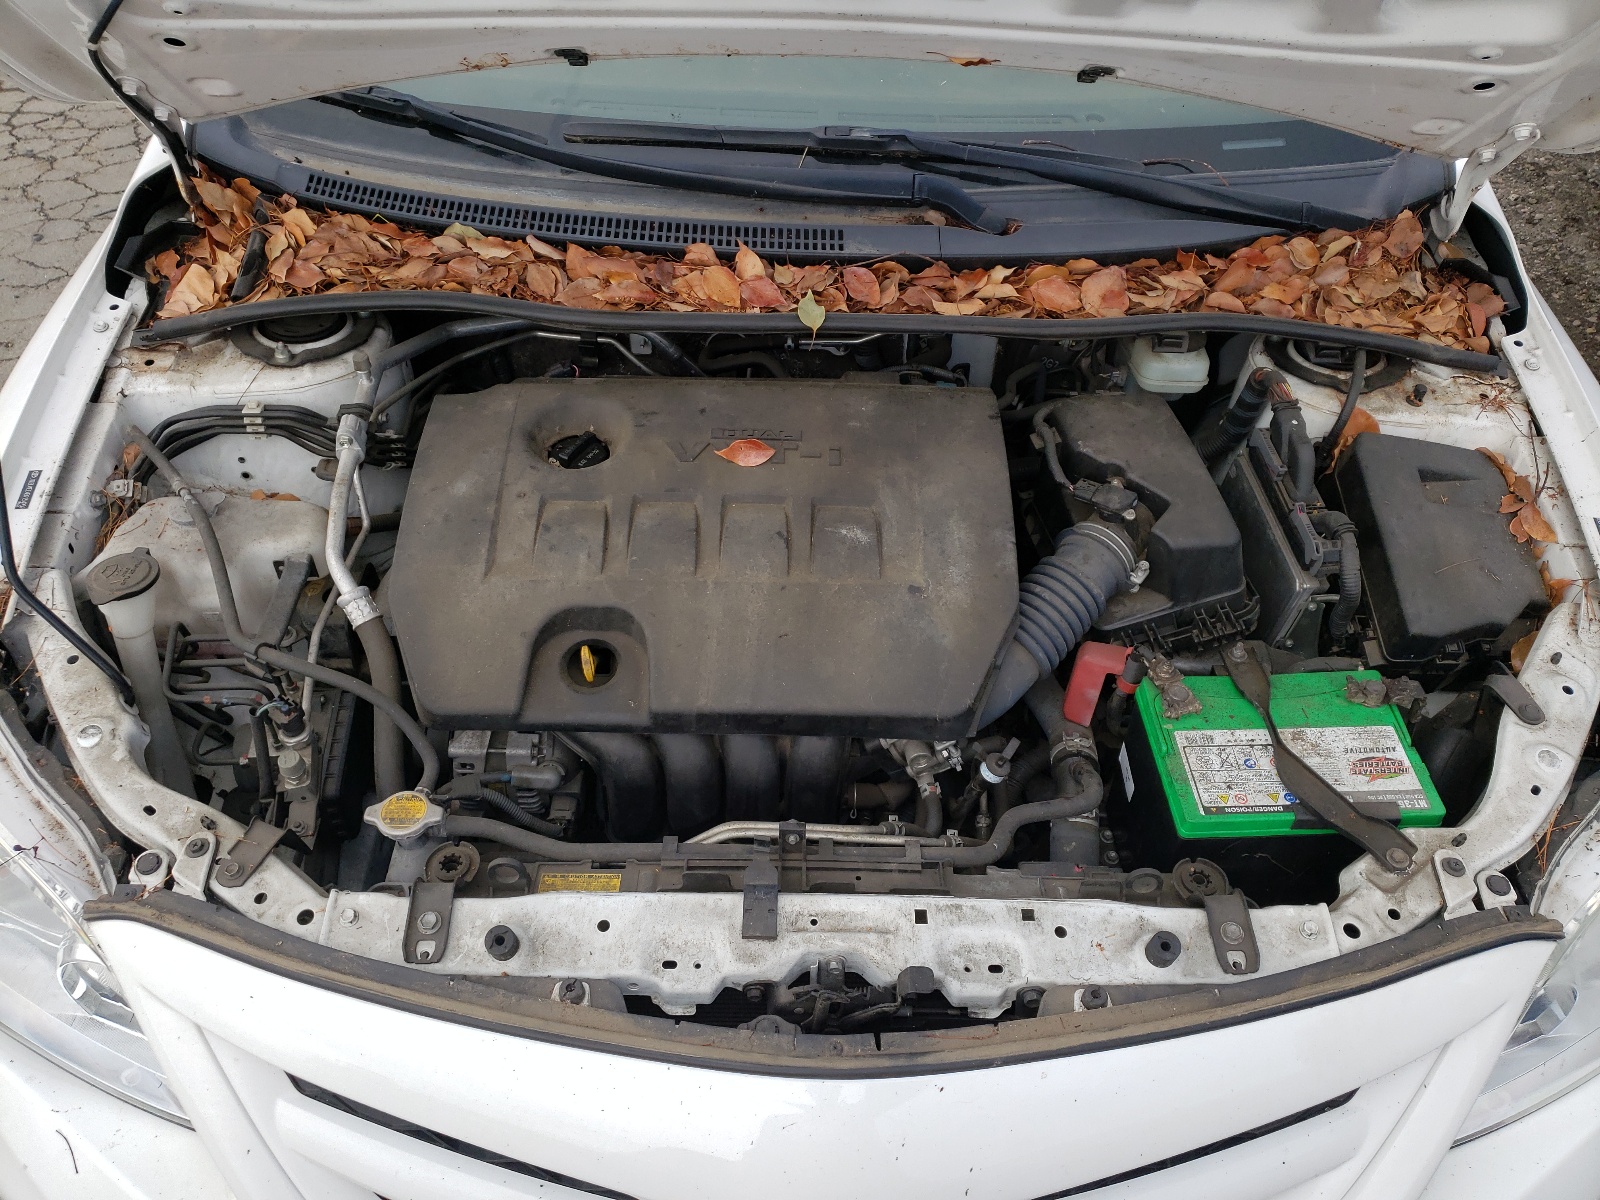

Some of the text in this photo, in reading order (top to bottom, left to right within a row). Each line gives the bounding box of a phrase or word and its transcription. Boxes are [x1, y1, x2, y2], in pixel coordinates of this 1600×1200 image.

[1343, 746, 1397, 754] AUTOMOTIVE
[1352, 760, 1403, 768] BATTERIES
[1350, 767, 1408, 775] INTERSTATE
[1399, 800, 1428, 808] MT-35
